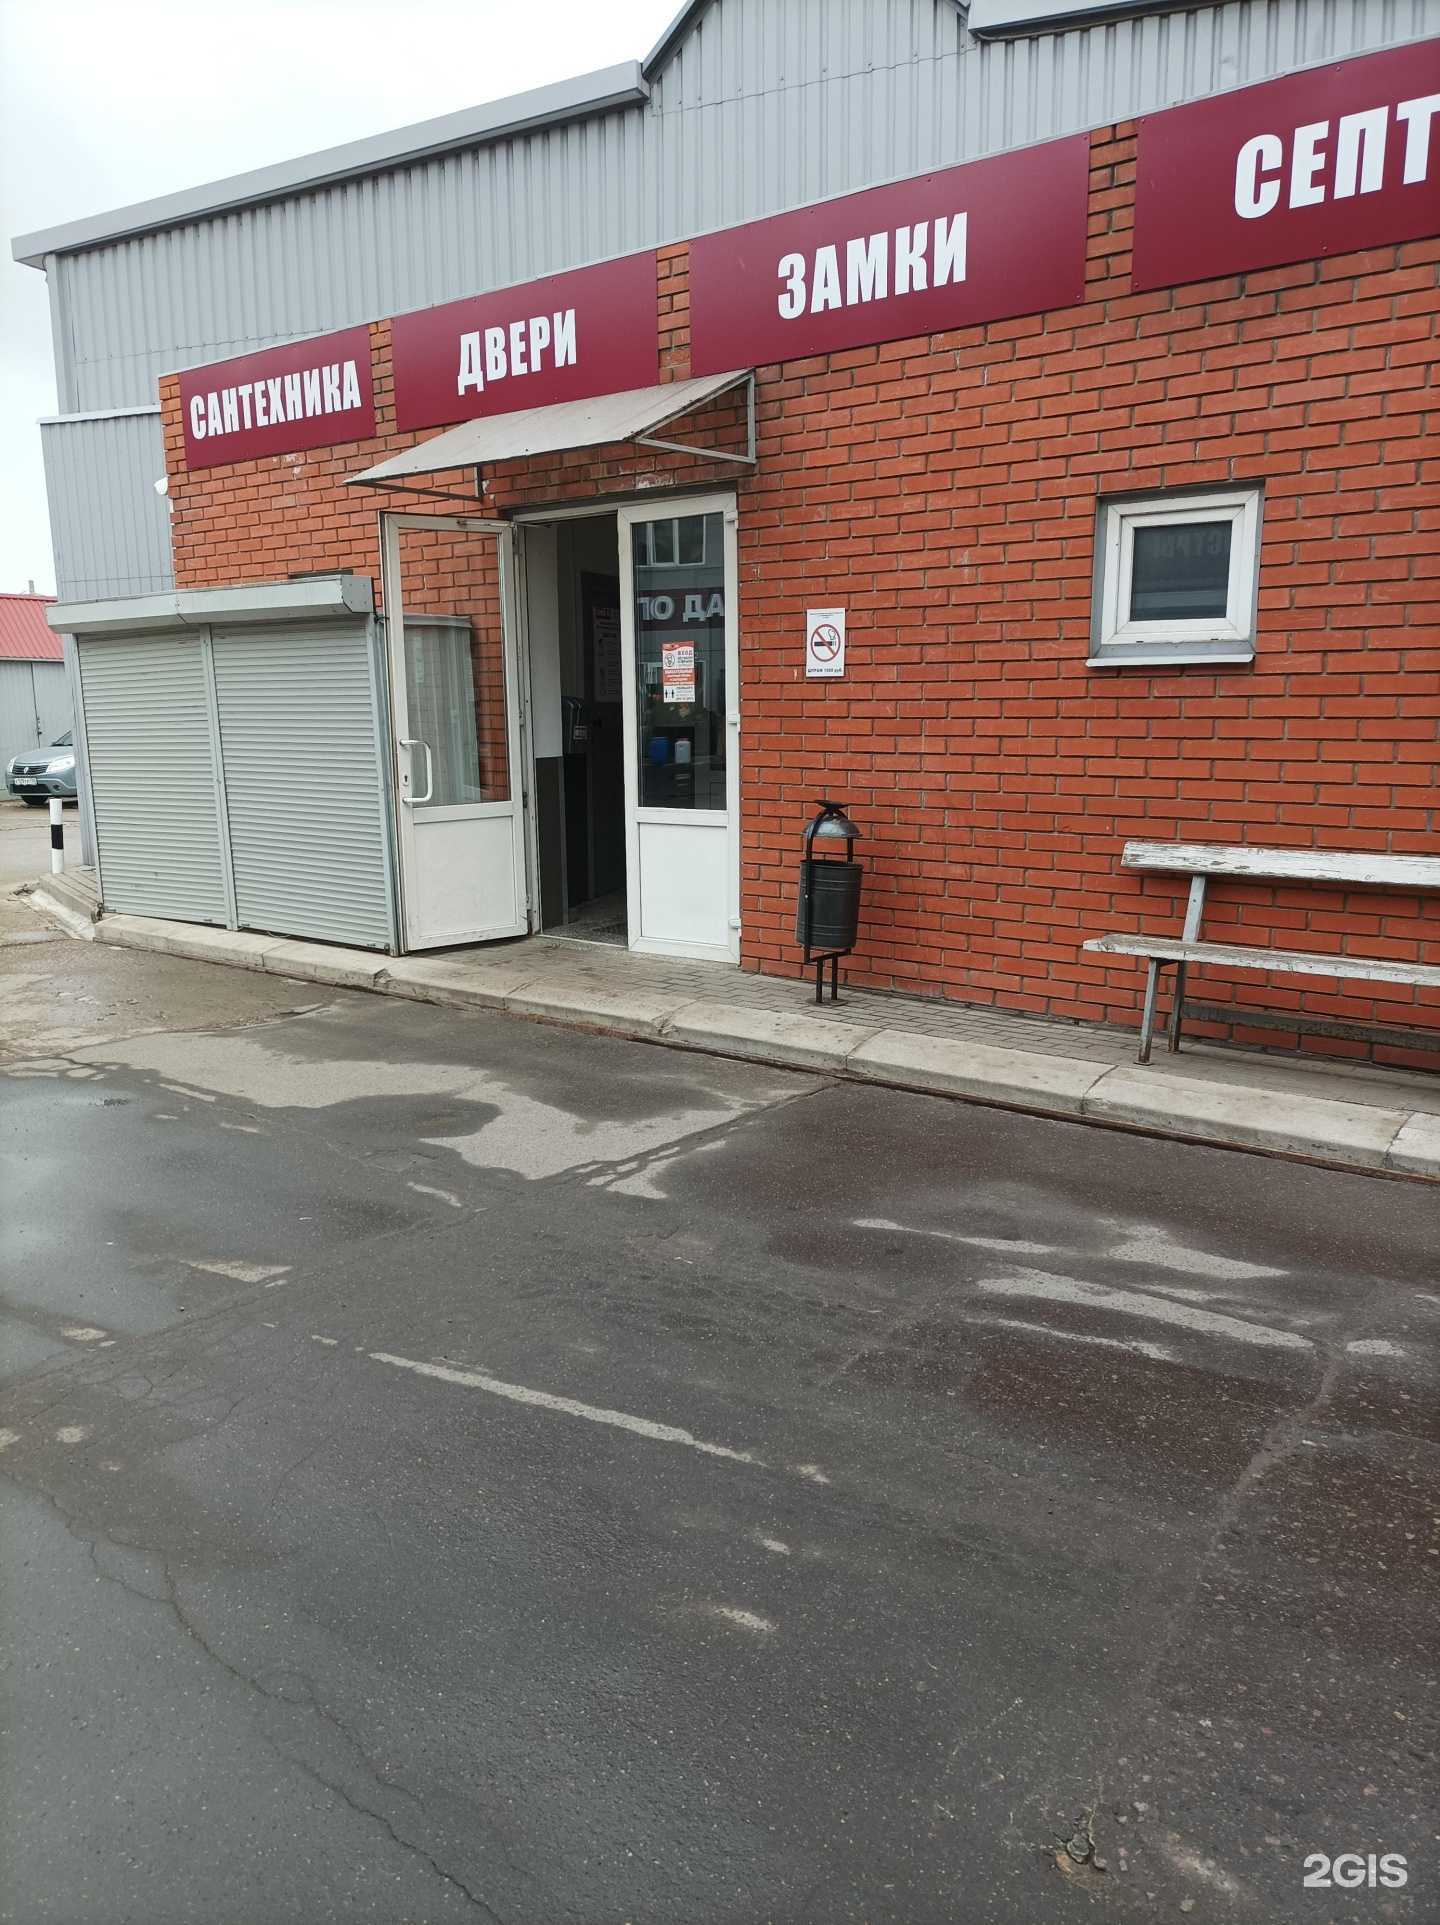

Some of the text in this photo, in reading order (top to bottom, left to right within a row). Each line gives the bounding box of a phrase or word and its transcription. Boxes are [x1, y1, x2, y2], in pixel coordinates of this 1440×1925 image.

[1235, 94, 1440, 219] СЕПТ
[778, 212, 967, 320] ЗАМКИ
[190, 360, 362, 440] САНТЕХНИКА
[458, 309, 577, 396] ДВЕРИ
